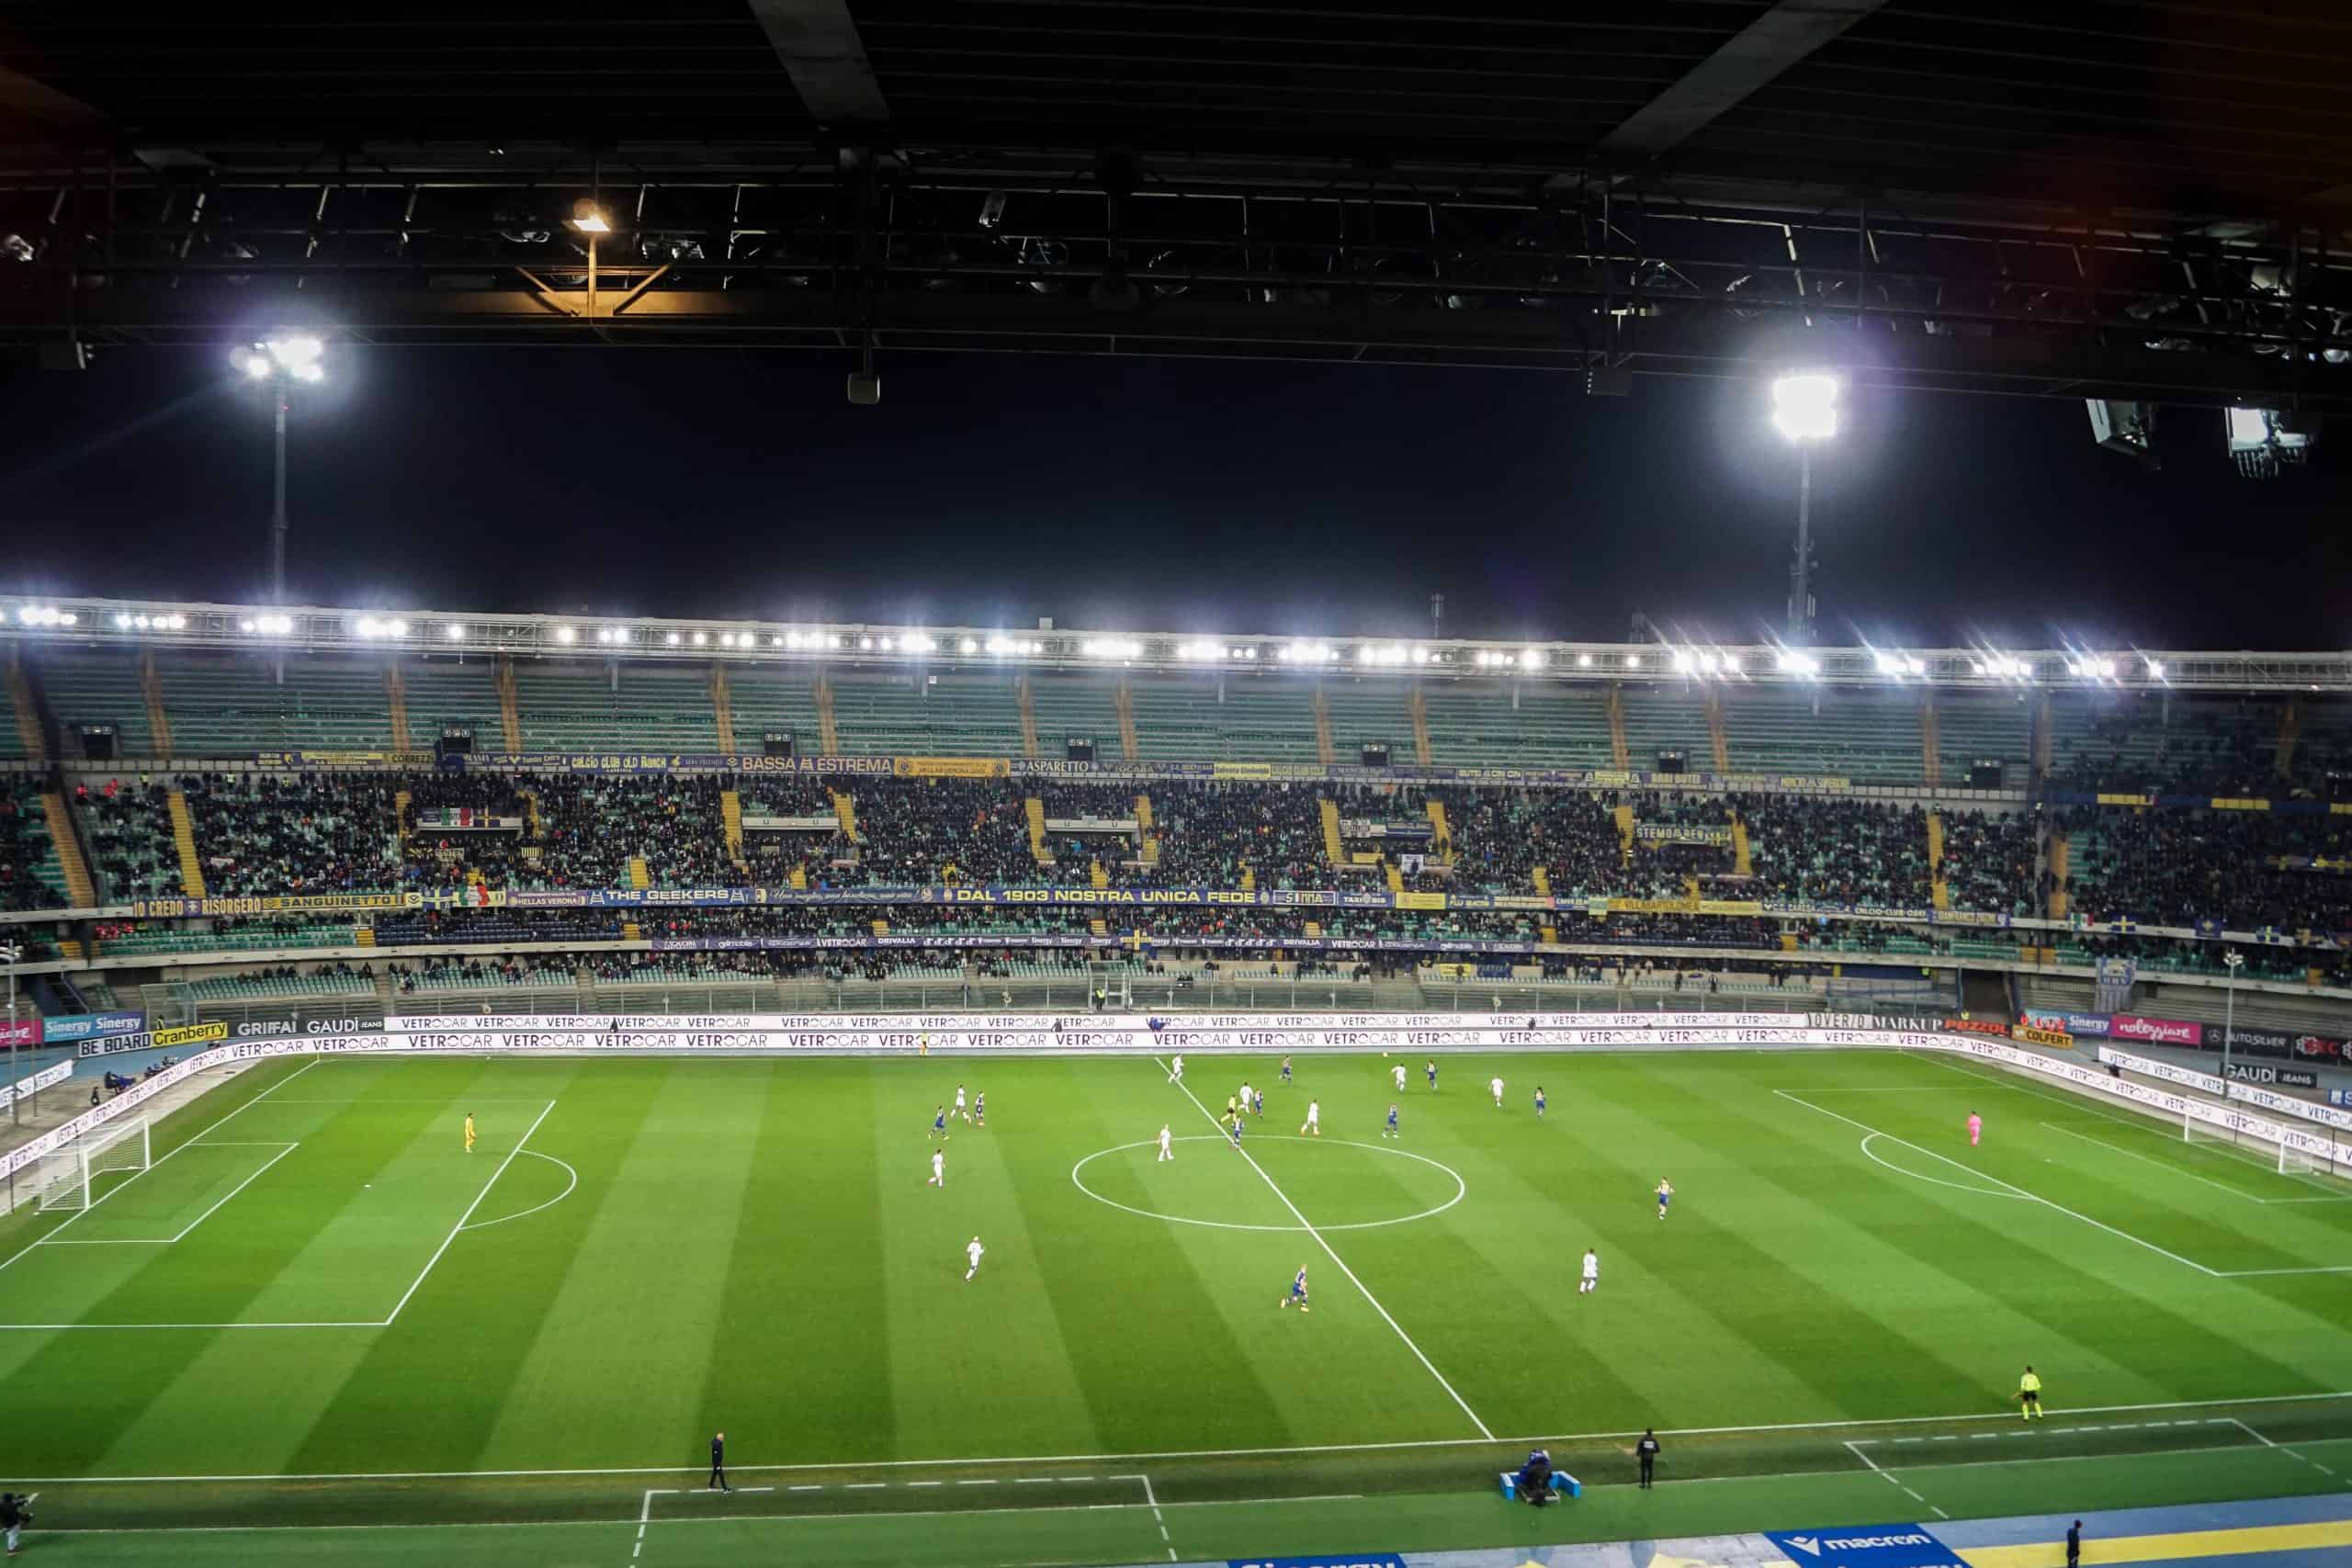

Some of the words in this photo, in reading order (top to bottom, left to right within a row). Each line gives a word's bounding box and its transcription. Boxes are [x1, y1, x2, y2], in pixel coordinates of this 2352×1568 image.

[742, 756, 797, 772] BASSA
[817, 758, 892, 773] ESTREMA
[1026, 761, 1089, 772] ASPARETTO
[280, 896, 391, 908] SANGUINETTO
[606, 890, 641, 900] THE
[647, 889, 729, 899] GEEKERS
[957, 890, 997, 901] DAL
[1002, 890, 1049, 901] 1903
[1055, 890, 1136, 902] NOSTRA
[1141, 891, 1201, 902] UNICA
[1207, 891, 1256, 903] FEDE
[133, 901, 145, 917] IO
[149, 900, 184, 917] CREDO
[201, 897, 262, 915] RISORGERO
[46, 1021, 92, 1034] Sinergy
[96, 1017, 141, 1030] Sinergy
[402, 1018, 467, 1029] VETROCAR
[475, 1017, 539, 1028] VETROCAR
[547, 1017, 610, 1028] VETROCAR
[617, 1017, 681, 1028] VETROCAR
[687, 1017, 751, 1028] VETROCAR
[782, 1017, 843, 1028] VETROCAR
[851, 1017, 912, 1028] VETROCAR
[920, 1017, 980, 1028] VETROCAR
[988, 1017, 1048, 1027] VETROCAR
[1211, 1017, 1270, 1026] VETROCAR
[1277, 1017, 1335, 1026] VETROCAR
[1872, 1015, 1943, 1031] MARKUP
[2069, 1015, 2110, 1030] Sinergy
[153, 1022, 226, 1044] Cranberry
[2026, 1030, 2071, 1045] COLFERT
[82, 1041, 98, 1055] BE
[104, 1034, 152, 1053] BOARD
[232, 1041, 304, 1057] VETROCAR
[312, 1036, 389, 1052] VETROCAR
[409, 1035, 492, 1047] VETROCAR
[503, 1034, 585, 1046] VETROCAR
[594, 1034, 676, 1046] VETROCAR
[686, 1034, 768, 1046] VETROCAR
[789, 1034, 869, 1046] VETROCAR
[968, 1034, 1046, 1045] VETROCAR
[1056, 1034, 1134, 1045] VETROCAR
[1154, 1033, 1230, 1045] VETROCAR
[1239, 1033, 1315, 1044] VETROCAR
[1324, 1032, 1398, 1044] VETROCAR
[1407, 1032, 1480, 1043] VETROCAR
[1499, 1032, 1571, 1043] VETROCAR
[1580, 1032, 1651, 1043] VETROCAR
[1659, 1031, 1728, 1043] VETROCAR
[1736, 1030, 1807, 1042] VETROCAR
[1825, 1032, 1890, 1043] VETROCAR
[1898, 1034, 1963, 1047] VETROCAR
[1823, 1533, 1932, 1551] macron
